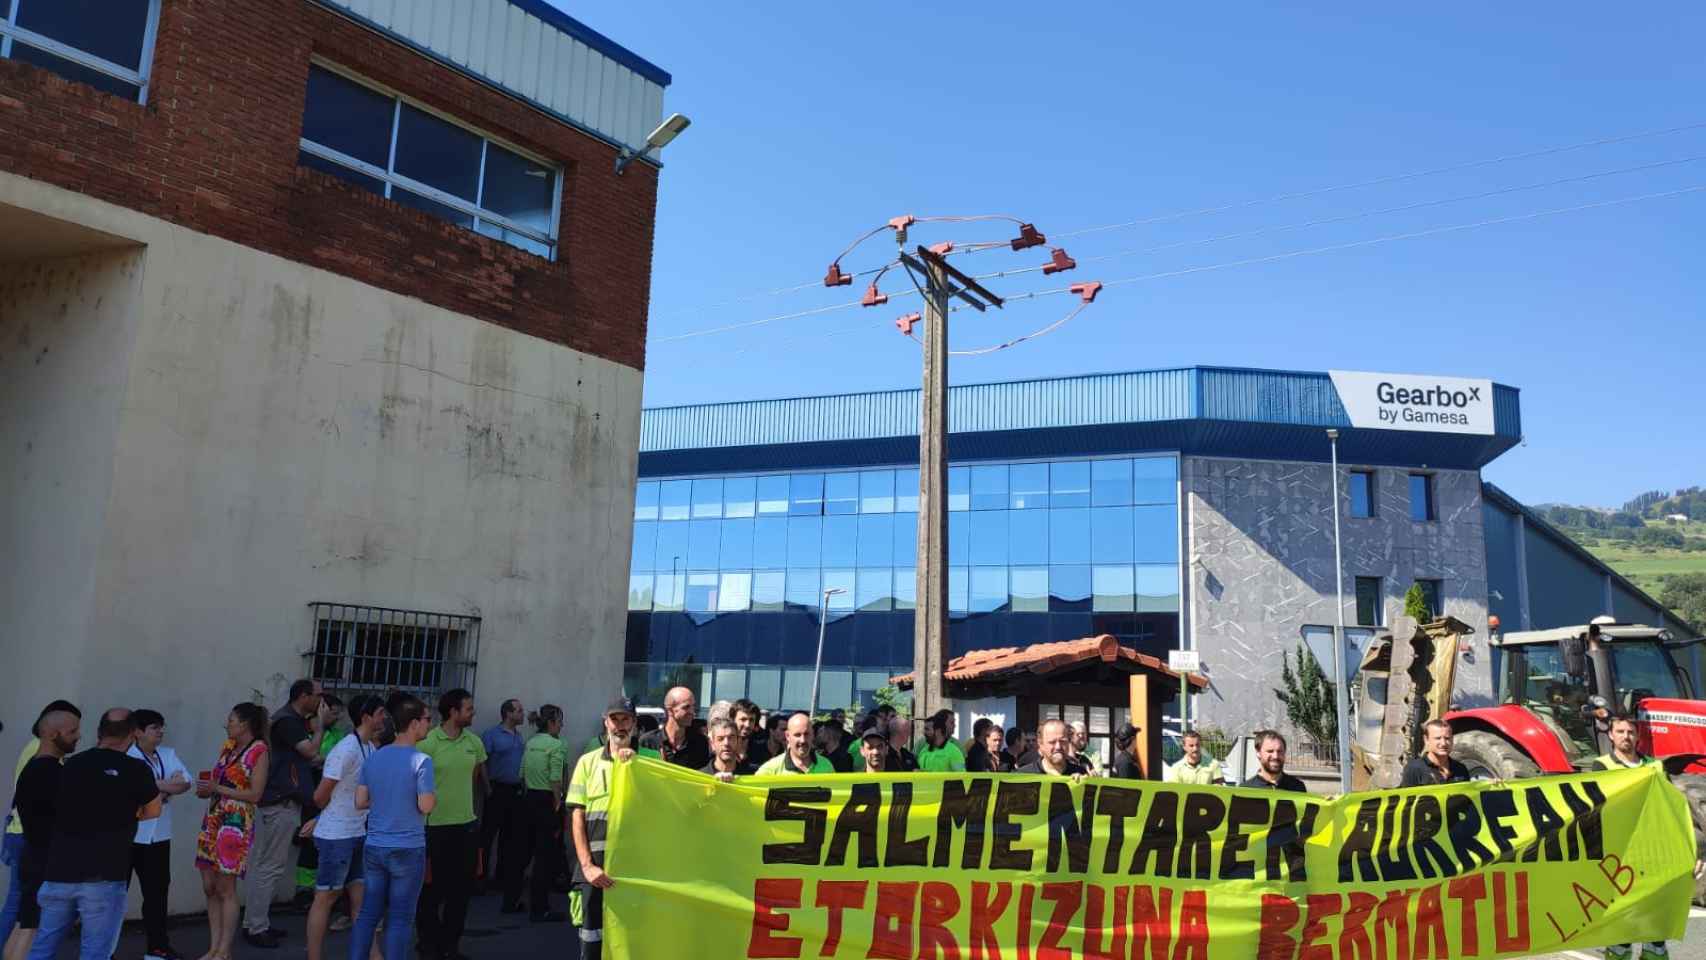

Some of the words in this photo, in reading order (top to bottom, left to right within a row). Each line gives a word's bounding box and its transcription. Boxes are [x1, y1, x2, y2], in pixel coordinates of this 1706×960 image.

[1379, 407, 1398, 424] by
[1402, 407, 1469, 425] Gamesa
[762, 778, 1320, 882] SALMENTAREN
[1338, 781, 1608, 883] AURREAN
[746, 877, 1210, 960] ETORKIZUNA
[1257, 870, 1531, 960] BERMATU
